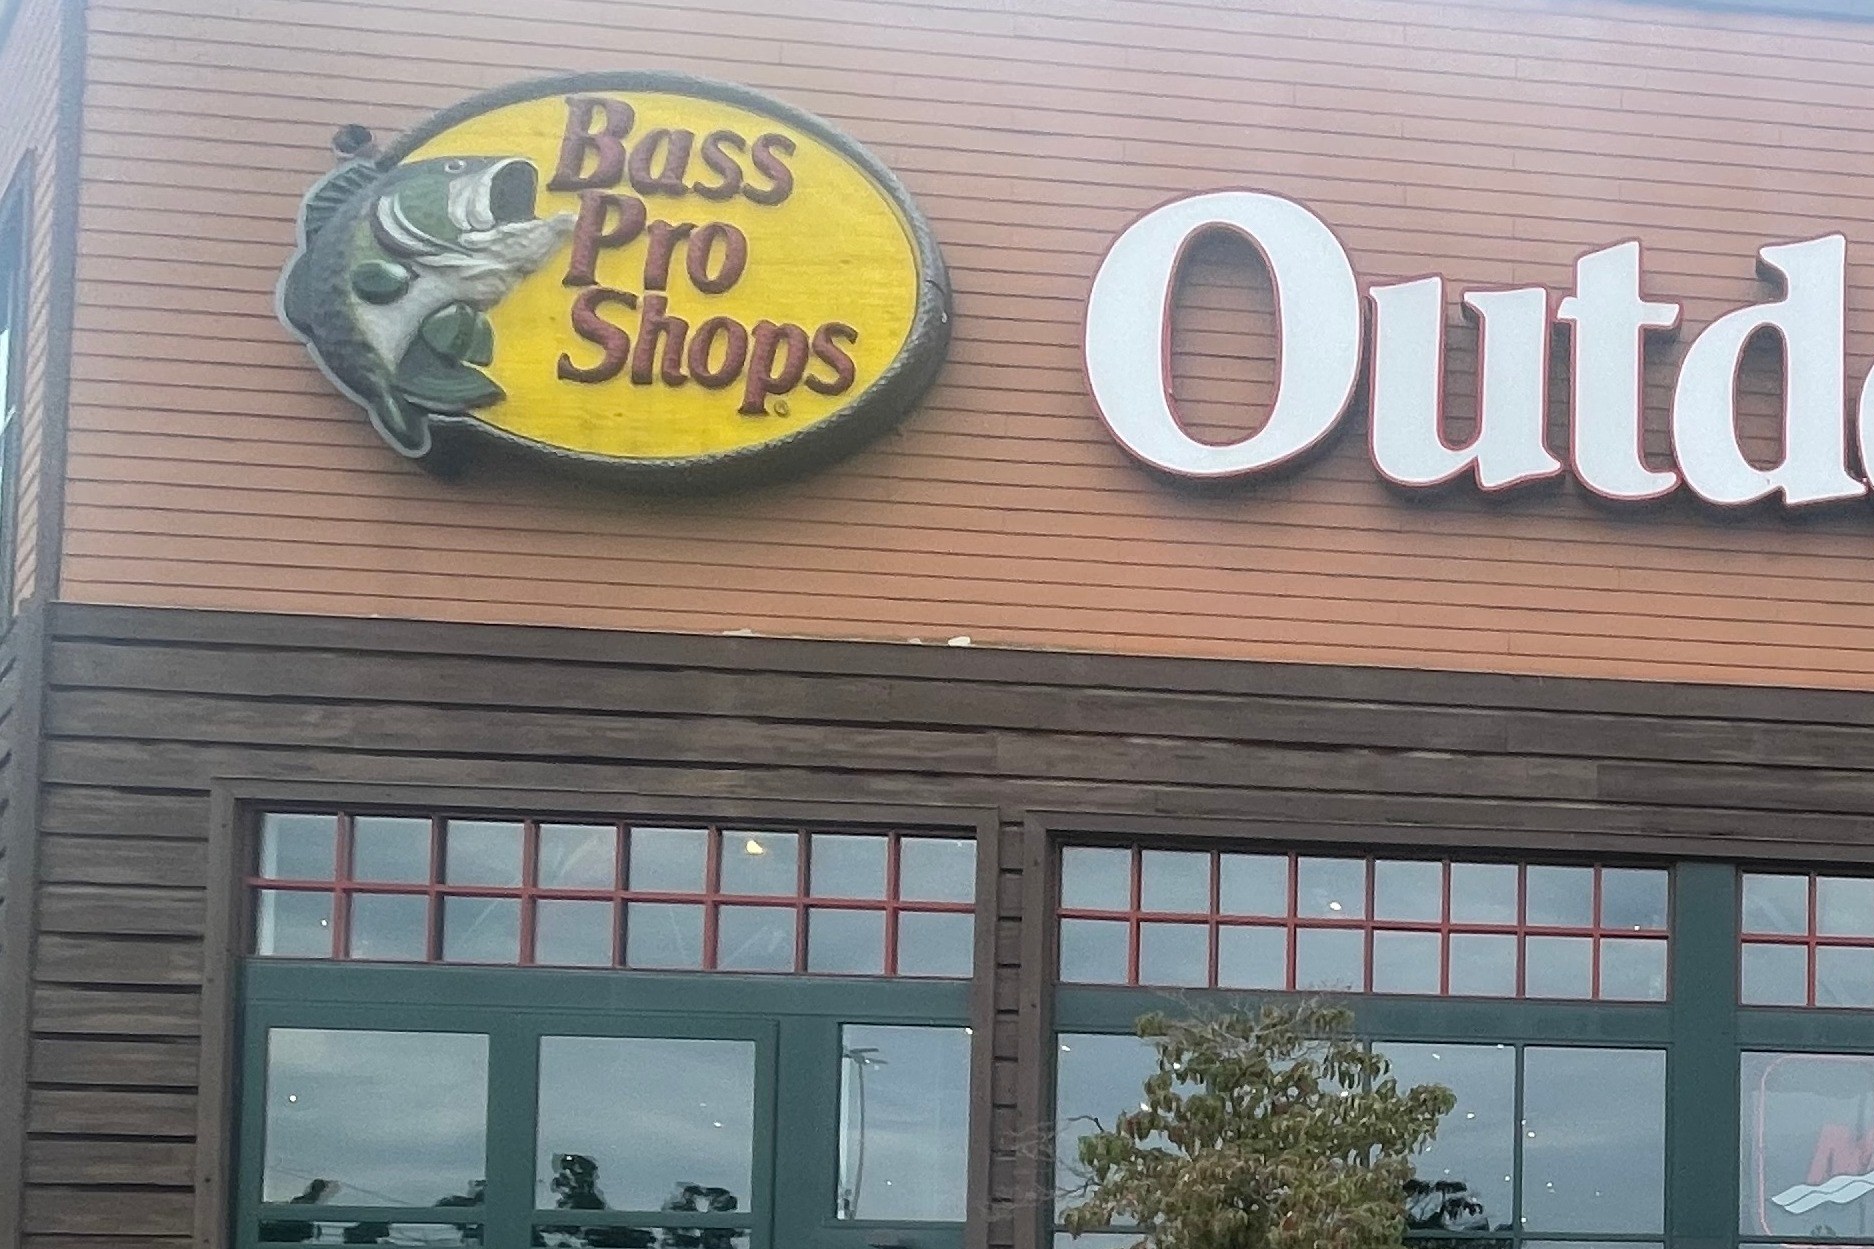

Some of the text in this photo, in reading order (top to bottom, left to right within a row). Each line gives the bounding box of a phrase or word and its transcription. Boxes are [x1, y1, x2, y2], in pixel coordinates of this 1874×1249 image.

[546, 95, 797, 206] Bass
[559, 188, 748, 296] Pro
[556, 287, 859, 417] Shops
